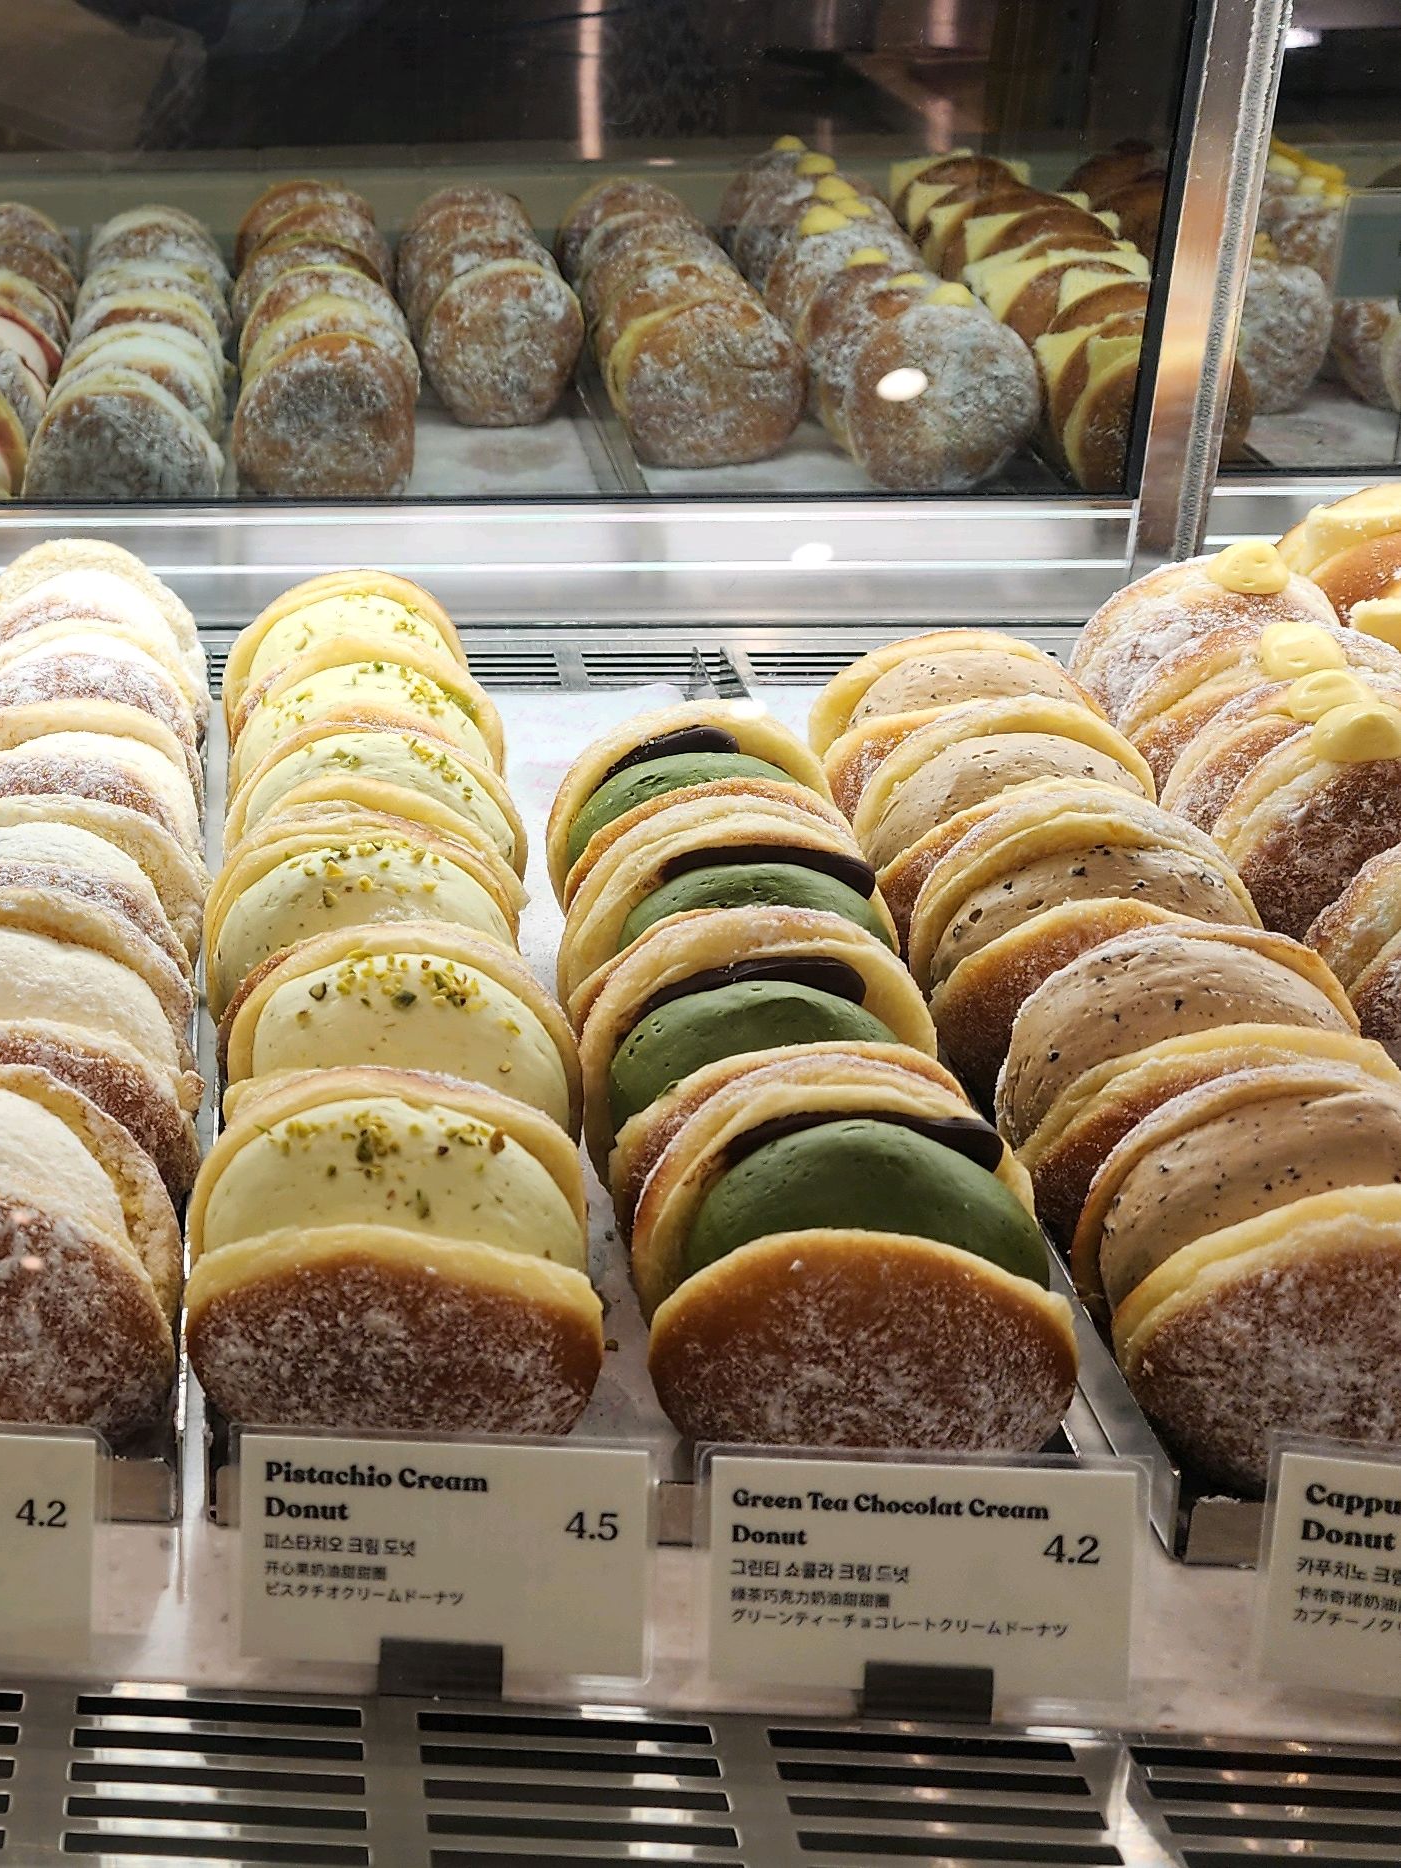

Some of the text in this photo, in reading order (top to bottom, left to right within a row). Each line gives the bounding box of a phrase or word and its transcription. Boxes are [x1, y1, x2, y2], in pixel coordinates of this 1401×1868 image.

[264, 1461, 489, 1492] Pistachio Cream
[15, 1498, 67, 1528] 4.2
[264, 1496, 350, 1520] Donut
[732, 1488, 1050, 1521] Green Tea Chocolat Cream
[1306, 1483, 1401, 1518] Cappu
[565, 1511, 619, 1541] 4.5
[731, 1524, 807, 1546] Donut
[1301, 1519, 1396, 1551] Donut
[264, 1532, 417, 1558] 피스타치오 크림 도넛
[1043, 1534, 1100, 1565] 4.2
[730, 1558, 780, 1578] 그린티
[838, 1563, 872, 1583] 크림
[1298, 1556, 1368, 1581] 카푸치노
[730, 1608, 1069, 1638] グリーンティーチョコレートクリームドーナツ
